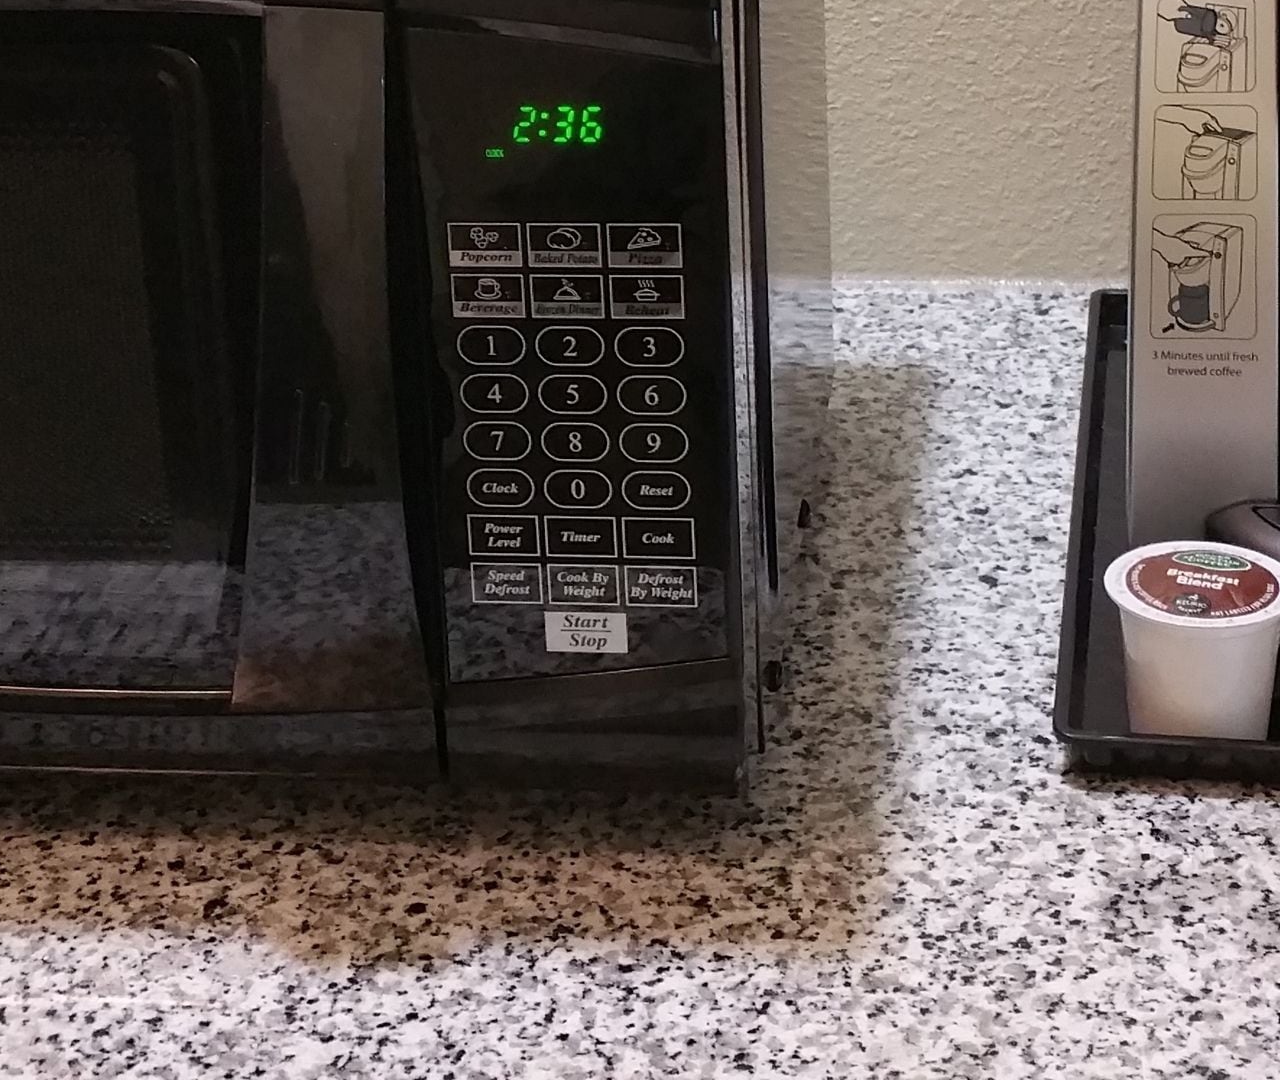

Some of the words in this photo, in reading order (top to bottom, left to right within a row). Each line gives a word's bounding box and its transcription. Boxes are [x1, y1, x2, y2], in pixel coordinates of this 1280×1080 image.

[512, 105, 602, 143] 2:36
[460, 251, 513, 264] Popcorn
[460, 302, 518, 316] Beverage
[487, 335, 497, 356] 1
[562, 335, 578, 357] 2
[643, 336, 656, 357] 3
[1152, 350, 1159, 360] 3
[1160, 350, 1204, 361] Minutes
[1205, 351, 1230, 361] until
[1232, 352, 1259, 362] fresh
[1167, 366, 1208, 376] brewed
[1209, 366, 1242, 377] coffee
[487, 383, 503, 404] 4
[566, 384, 579, 405] 5
[644, 385, 659, 406] 6
[490, 430, 504, 451] 7
[568, 431, 582, 453] 8
[646, 432, 661, 454] 9
[482, 482, 519, 494] Clock
[570, 478, 586, 500] 0
[639, 484, 673, 497] Reset
[484, 523, 524, 535] Power
[487, 536, 521, 548] Level
[560, 531, 601, 543] Timer
[641, 532, 675, 544] Cook
[487, 570, 525, 583] Speed
[556, 571, 588, 584] Cook
[590, 572, 609, 587] By
[637, 572, 684, 586] Defrost
[1166, 568, 1240, 587] Breakfast
[1176, 575, 1224, 590] Blend
[484, 582, 530, 596] Defrost
[563, 584, 606, 599] Weight
[630, 586, 648, 600] By
[652, 586, 694, 601] Weight
[563, 614, 608, 629] Start
[569, 633, 608, 651] Stop
